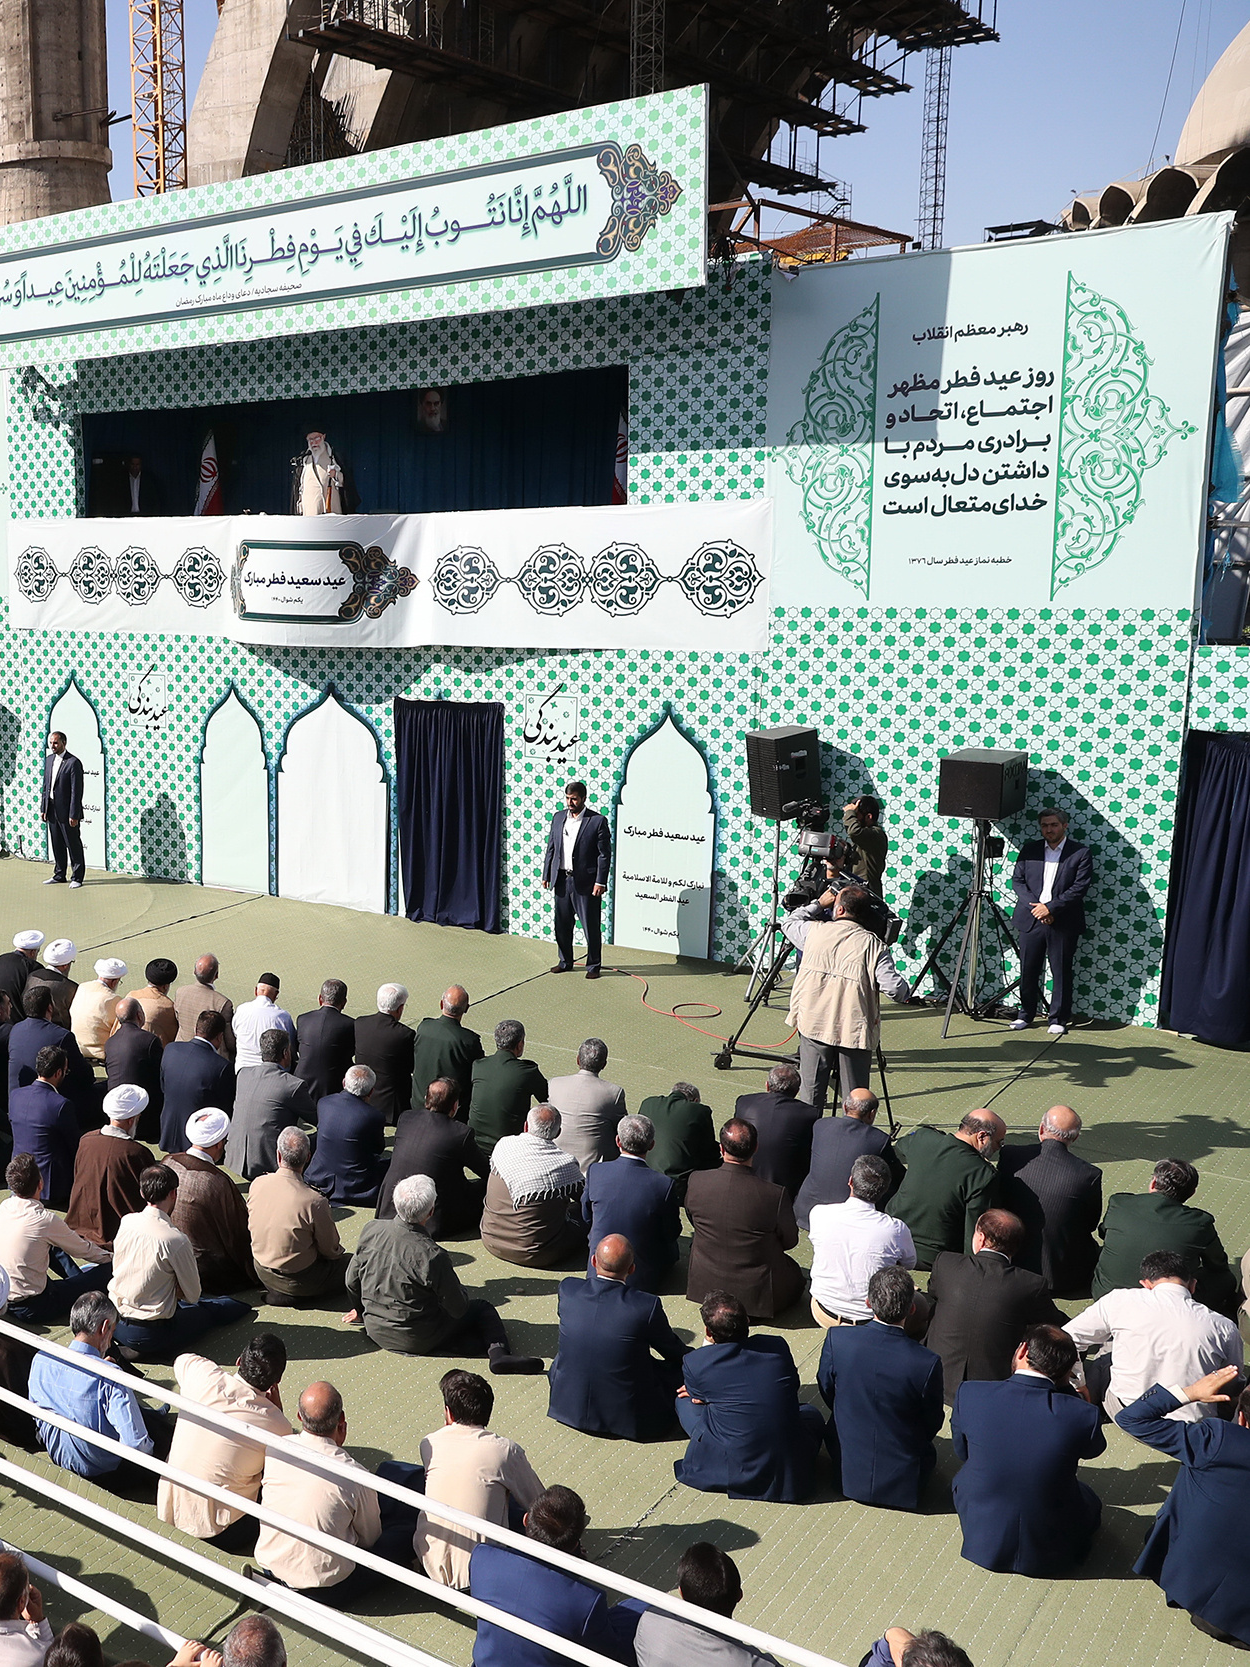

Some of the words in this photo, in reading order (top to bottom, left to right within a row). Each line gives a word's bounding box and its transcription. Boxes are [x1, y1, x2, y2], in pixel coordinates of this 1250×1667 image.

[912, 325, 953, 346] انقلاب
[954, 324, 996, 343] معظم
[997, 321, 1029, 339] رهبر
[887, 373, 940, 399] مظهر
[940, 366, 981, 394] فطر
[983, 372, 1022, 390] عید
[1023, 367, 1055, 389] روز
[898, 401, 958, 424] اتحاد
[885, 415, 896, 429] و
[884, 436, 910, 459] با
[913, 436, 975, 460] مردم
[977, 429, 1051, 454] برادری
[950, 463, 980, 486] دل
[982, 460, 1050, 487] داشتن
[882, 496, 928, 515] است
[931, 494, 991, 517] متعال
[991, 491, 1048, 516] خدای
[927, 556, 943, 565] سال
[943, 555, 959, 566] فطر
[959, 557, 974, 566] عید
[974, 556, 991, 566] نماز
[991, 556, 1012, 566] خطبه
[244, 571, 266, 588] مبارک
[266, 571, 286, 587] فطر
[287, 575, 322, 589] سعید
[322, 576, 346, 589] عید
[281, 596, 293, 604] شوال
[550, 735, 581, 764] عید
[623, 826, 647, 840] مبارک
[648, 827, 664, 838] فطر
[664, 831, 689, 842] سعید
[690, 832, 706, 844] عید
[635, 892, 659, 900] السعید
[659, 894, 676, 903] الفطر
[677, 897, 690, 906] عید
[654, 928, 668, 936] شوال
[668, 930, 680, 938] یکم
